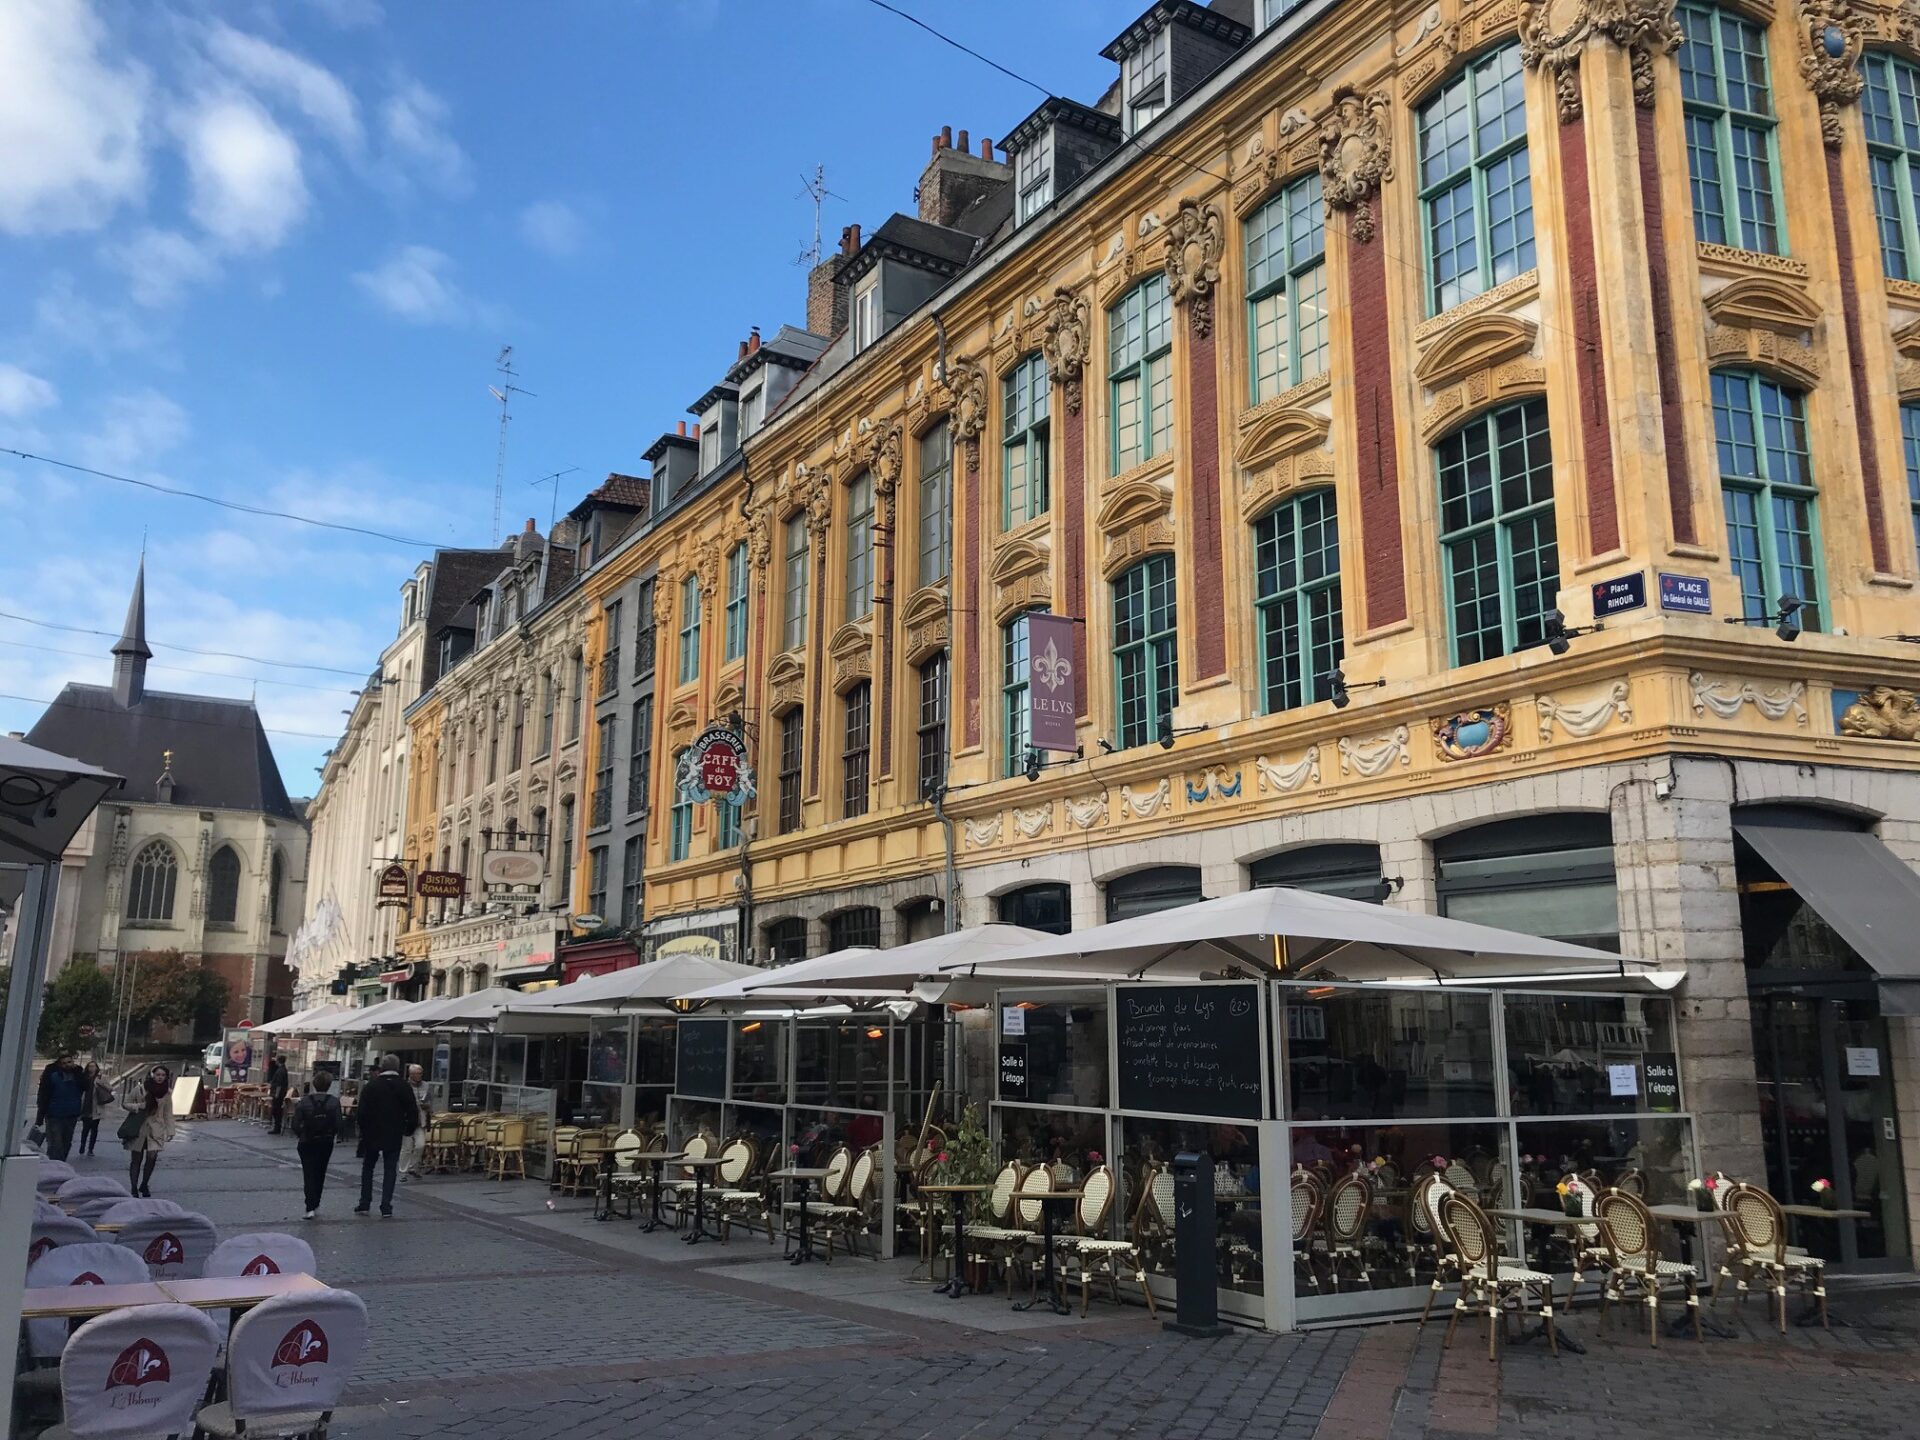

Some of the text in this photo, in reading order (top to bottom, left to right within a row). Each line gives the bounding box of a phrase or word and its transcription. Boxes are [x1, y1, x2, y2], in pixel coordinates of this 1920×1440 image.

[1610, 583, 1629, 594] Place
[1678, 582, 1702, 594] PLACE
[1608, 594, 1634, 608] RIHOUR
[1663, 594, 1710, 607] du Général de GAULLE
[1033, 698, 1074, 714] LE LYS
[698, 731, 743, 752] BRASSERIE
[703, 754, 738, 766] CAFE
[707, 774, 733, 786] FOY
[426, 875, 457, 885] BISTRO
[421, 883, 460, 894] ROMAIN
[488, 893, 537, 902] Kronenbourg
[1127, 998, 1165, 1015] Brunch
[1174, 997, 1187, 1012] du
[1194, 994, 1215, 1020] Lys
[1002, 1056, 1024, 1067] Salle à
[1194, 1056, 1220, 1070] bacon
[1647, 1065, 1673, 1076] Salle à
[1002, 1071, 1024, 1086] l'étage
[1648, 1082, 1676, 1096] l'étage
[275, 1371, 320, 1388] L'Abbaye
[111, 1391, 161, 1409] L'Abbaye
